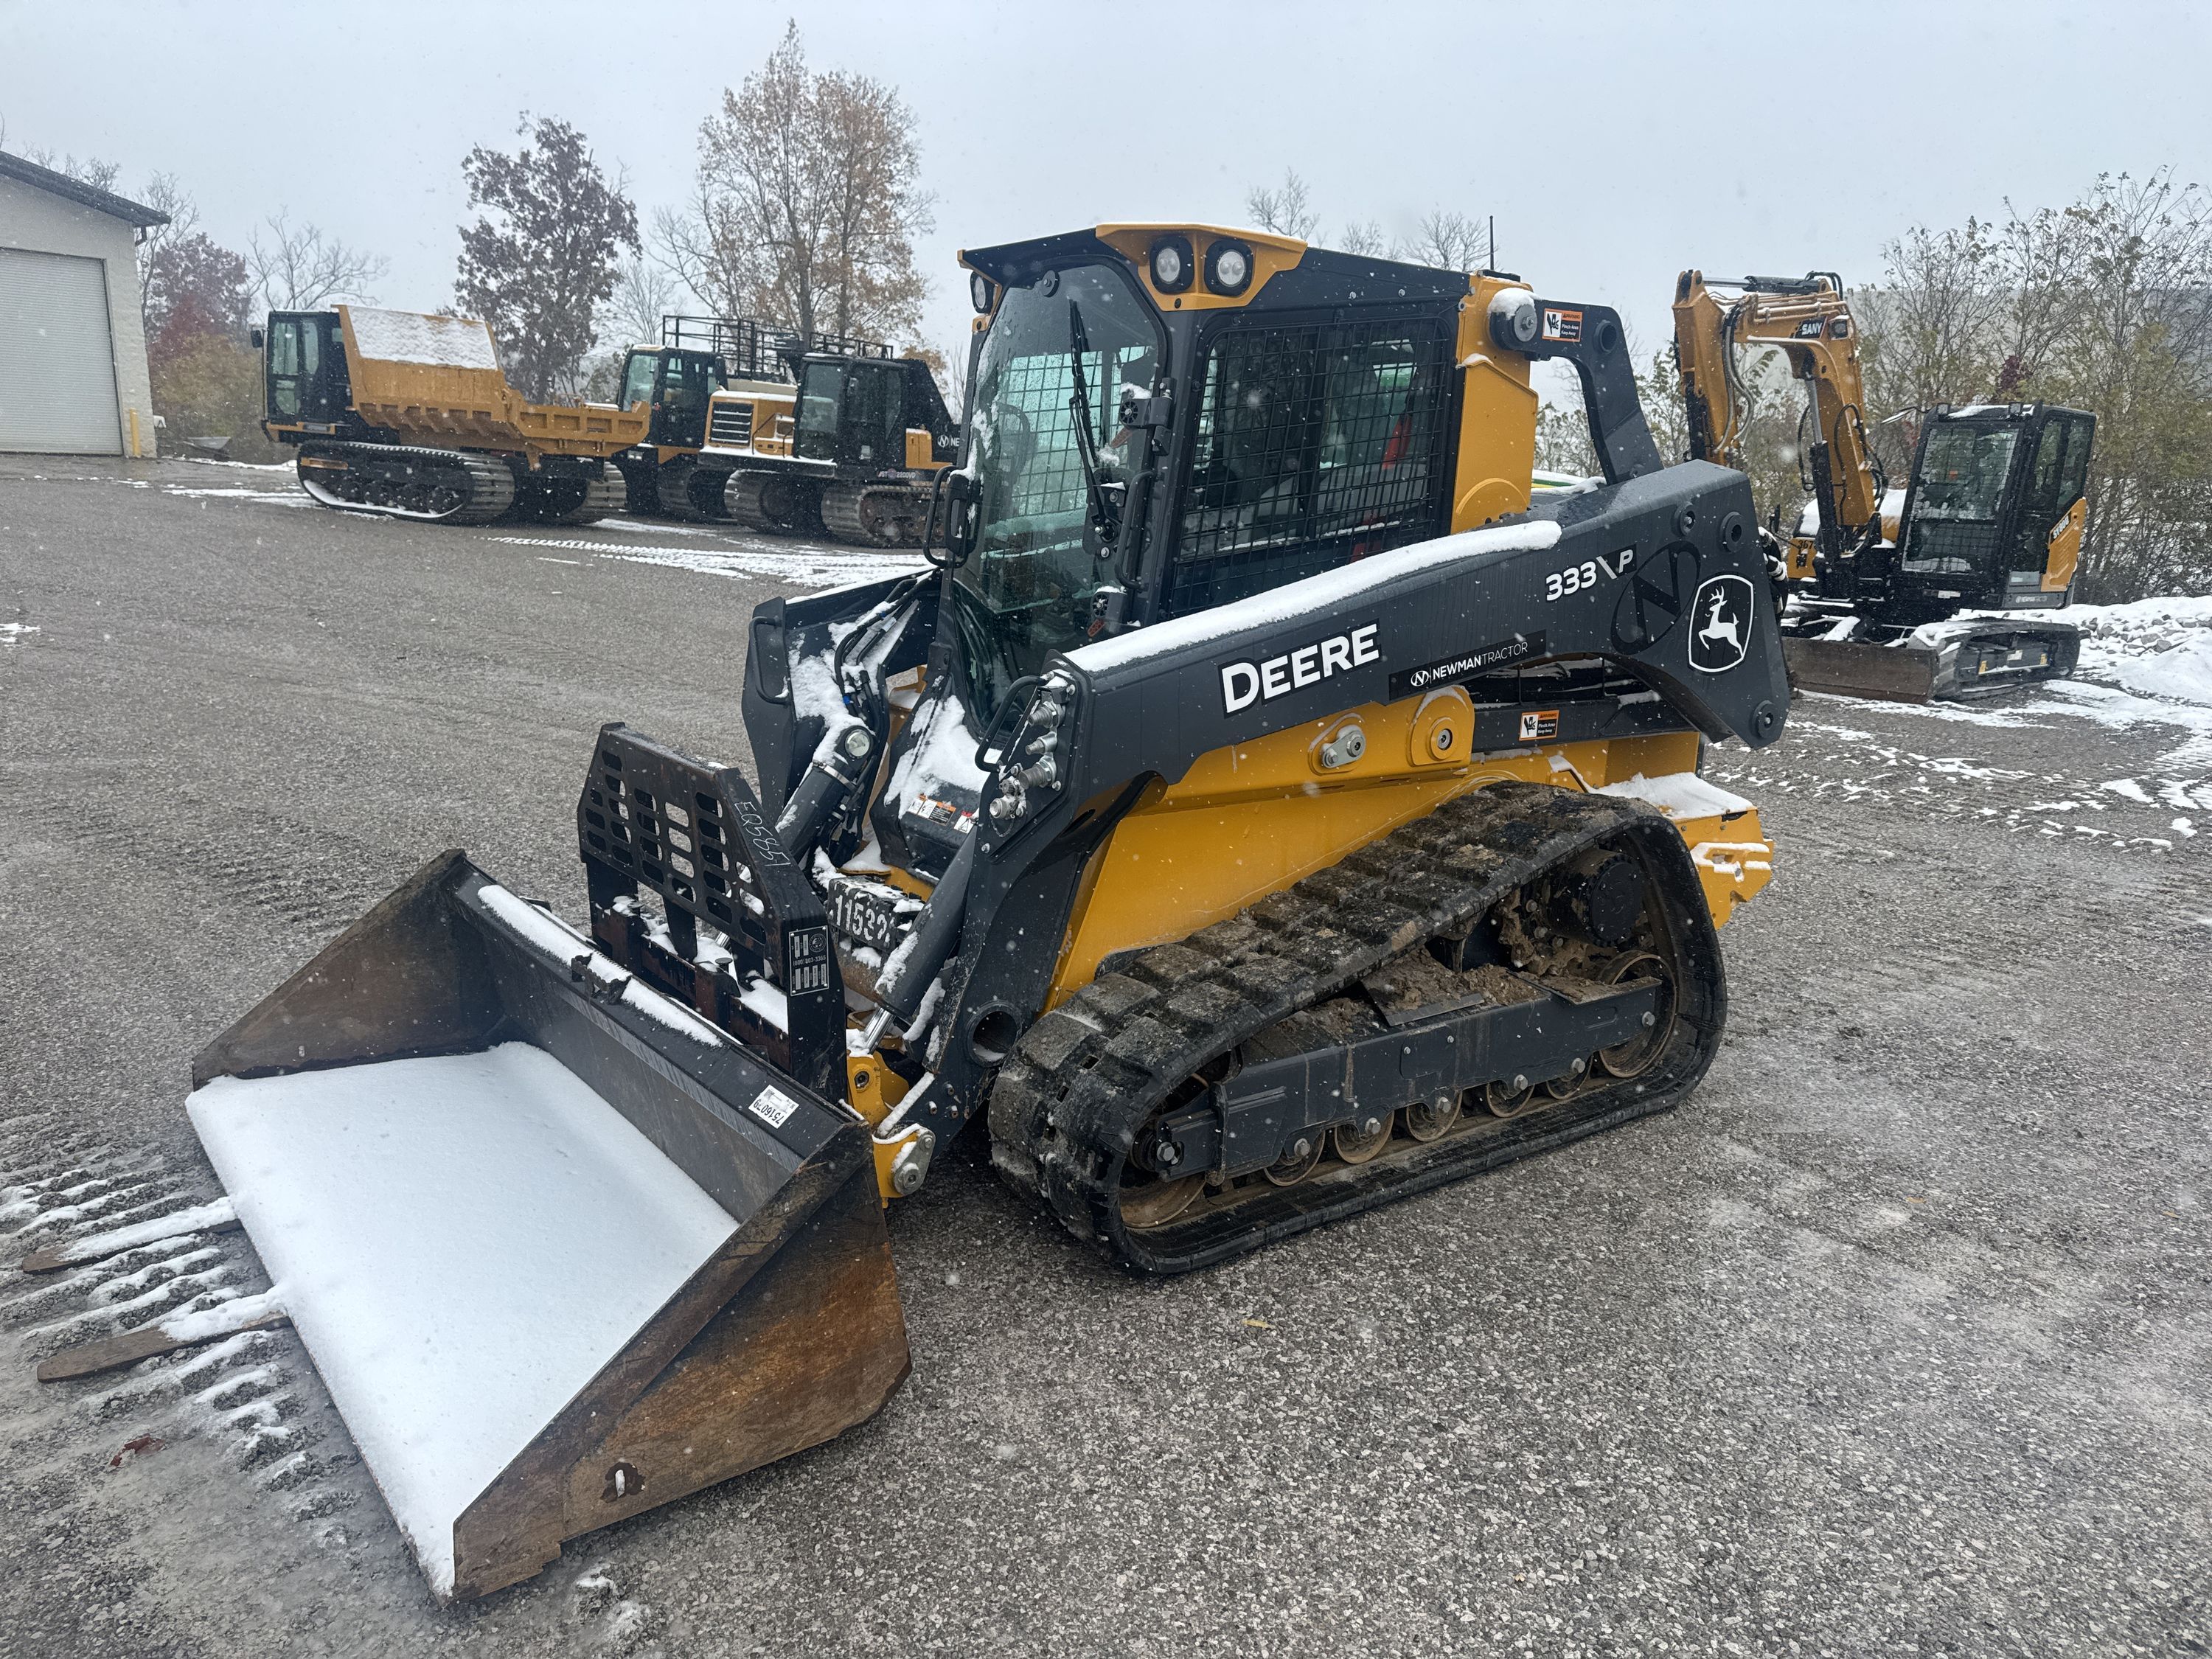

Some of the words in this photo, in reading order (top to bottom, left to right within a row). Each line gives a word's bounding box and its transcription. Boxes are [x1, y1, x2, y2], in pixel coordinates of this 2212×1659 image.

[1802, 322, 1823, 335] SANY
[1222, 623, 1380, 713] DEERE
[734, 801, 791, 866] EQ5851
